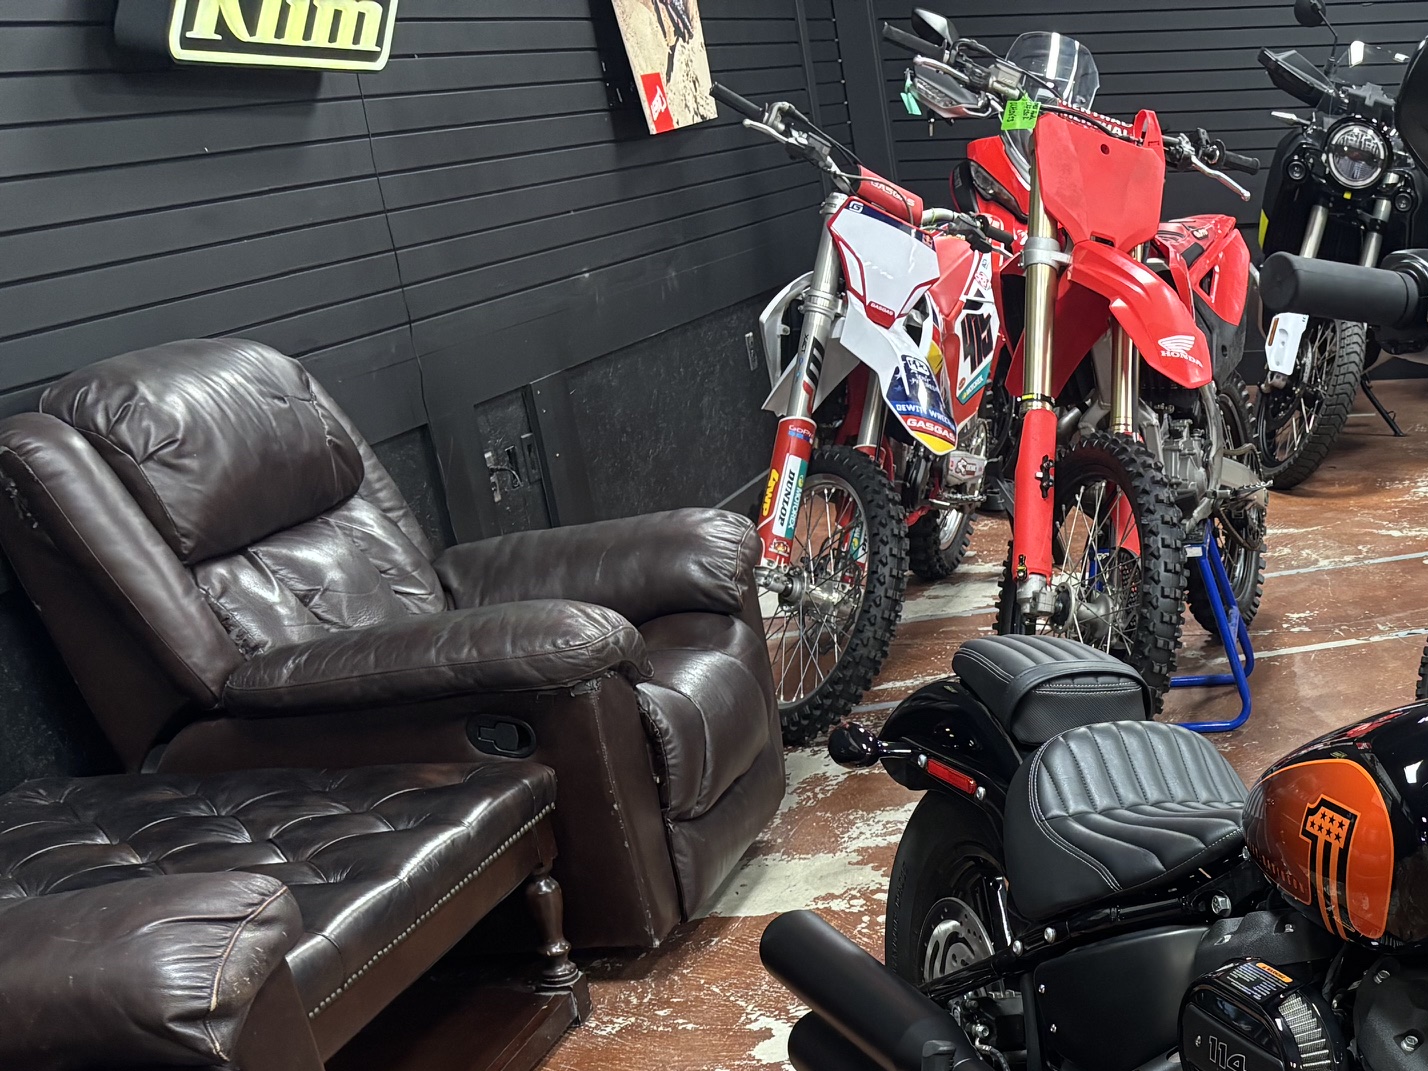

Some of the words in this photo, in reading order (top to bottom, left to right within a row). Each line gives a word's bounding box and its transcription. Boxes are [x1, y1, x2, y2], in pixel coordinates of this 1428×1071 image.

[870, 302, 894, 316] GASGAS
[1160, 350, 1203, 368] HONDA
[906, 418, 956, 442] GASGAS
[779, 468, 796, 527] DUNLOP
[788, 486, 802, 530] MOTOREX
